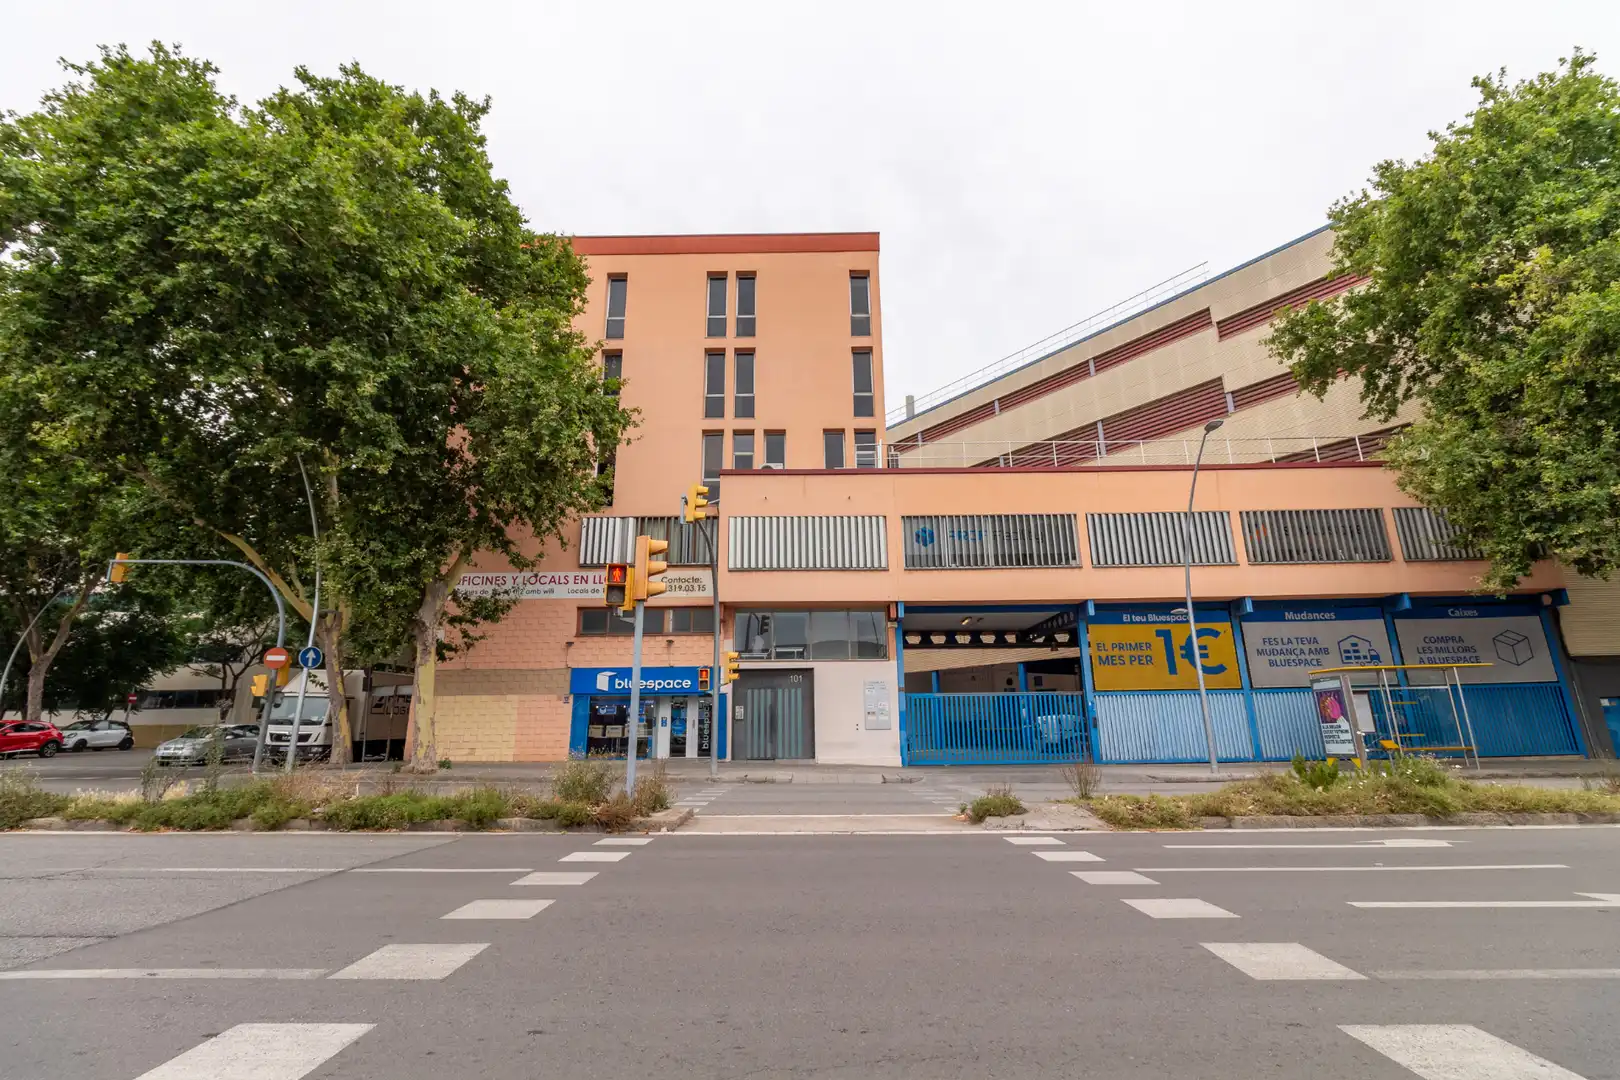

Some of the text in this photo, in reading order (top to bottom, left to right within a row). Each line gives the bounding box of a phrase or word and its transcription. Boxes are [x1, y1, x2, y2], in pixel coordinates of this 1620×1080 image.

[511, 575, 518, 586] Y
[523, 575, 569, 586] LOCALS
[573, 575, 588, 585] EN
[593, 574, 606, 585] LL
[525, 587, 542, 595] amb
[1123, 613, 1131, 622] El
[1132, 613, 1147, 622] teu
[1284, 611, 1336, 621] Mudances
[1447, 608, 1479, 617] Caixes
[1262, 636, 1319, 646] FES LA TEVA
[1423, 635, 1465, 645] COMPRA
[1096, 642, 1153, 652] EL PRIMER
[1154, 627, 1228, 676] 1€
[1416, 645, 1477, 655] LES MILLORS
[1256, 647, 1330, 658] MUDANÇA AMB
[1098, 655, 1154, 666] MES PER
[1268, 658, 1323, 668] BLUESPACE
[1418, 655, 1482, 665] A BLUESPACE
[790, 674, 803, 683] 101
[702, 704, 711, 749] bluespac
